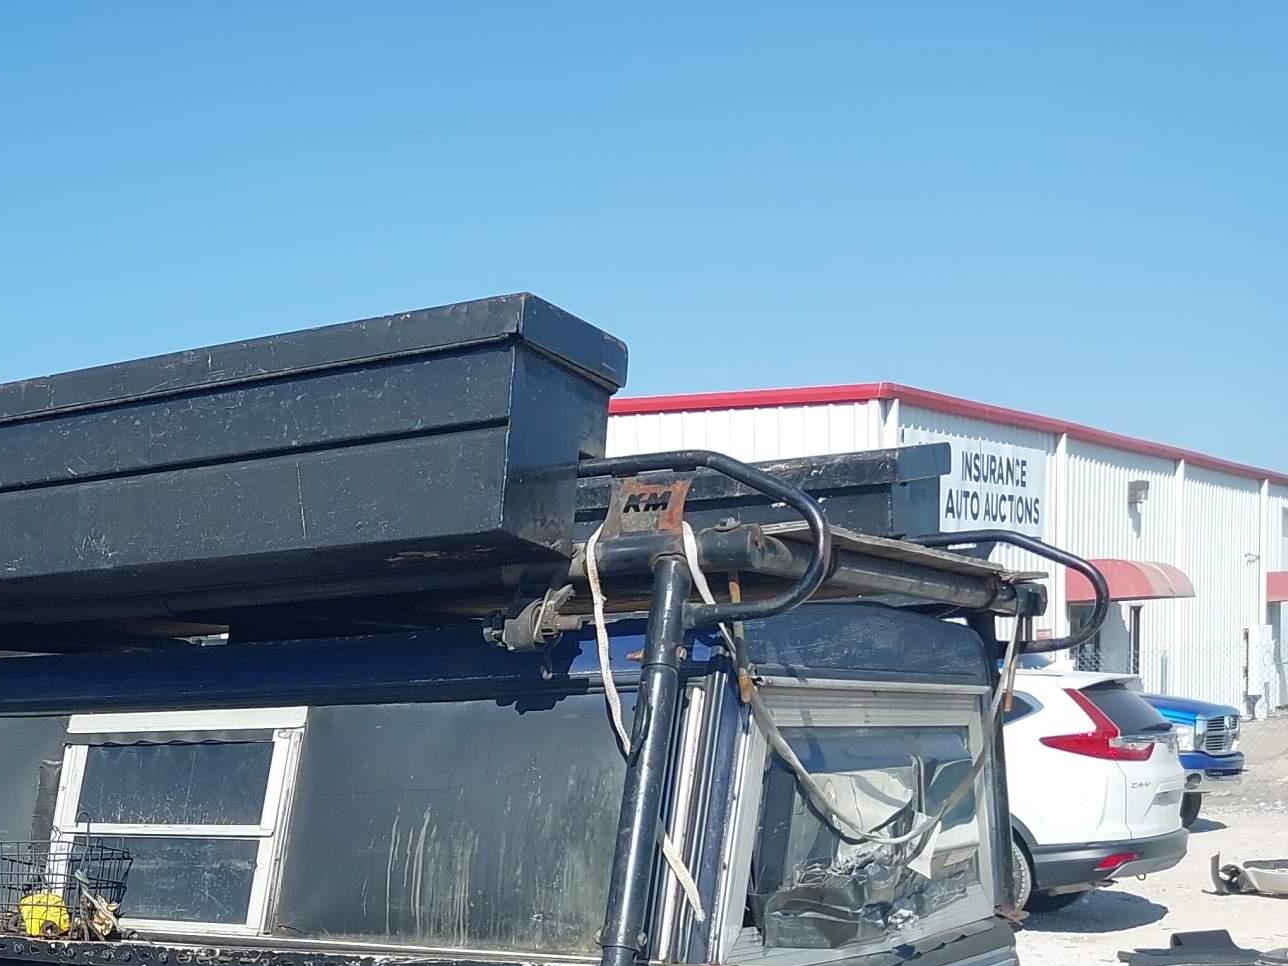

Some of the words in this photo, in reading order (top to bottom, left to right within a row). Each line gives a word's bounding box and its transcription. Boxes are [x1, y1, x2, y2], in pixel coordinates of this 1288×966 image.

[962, 450, 1027, 488] INSURANCE
[623, 490, 672, 513] KM
[945, 488, 980, 521] AUTO
[983, 493, 1040, 525] AUCTIONS
